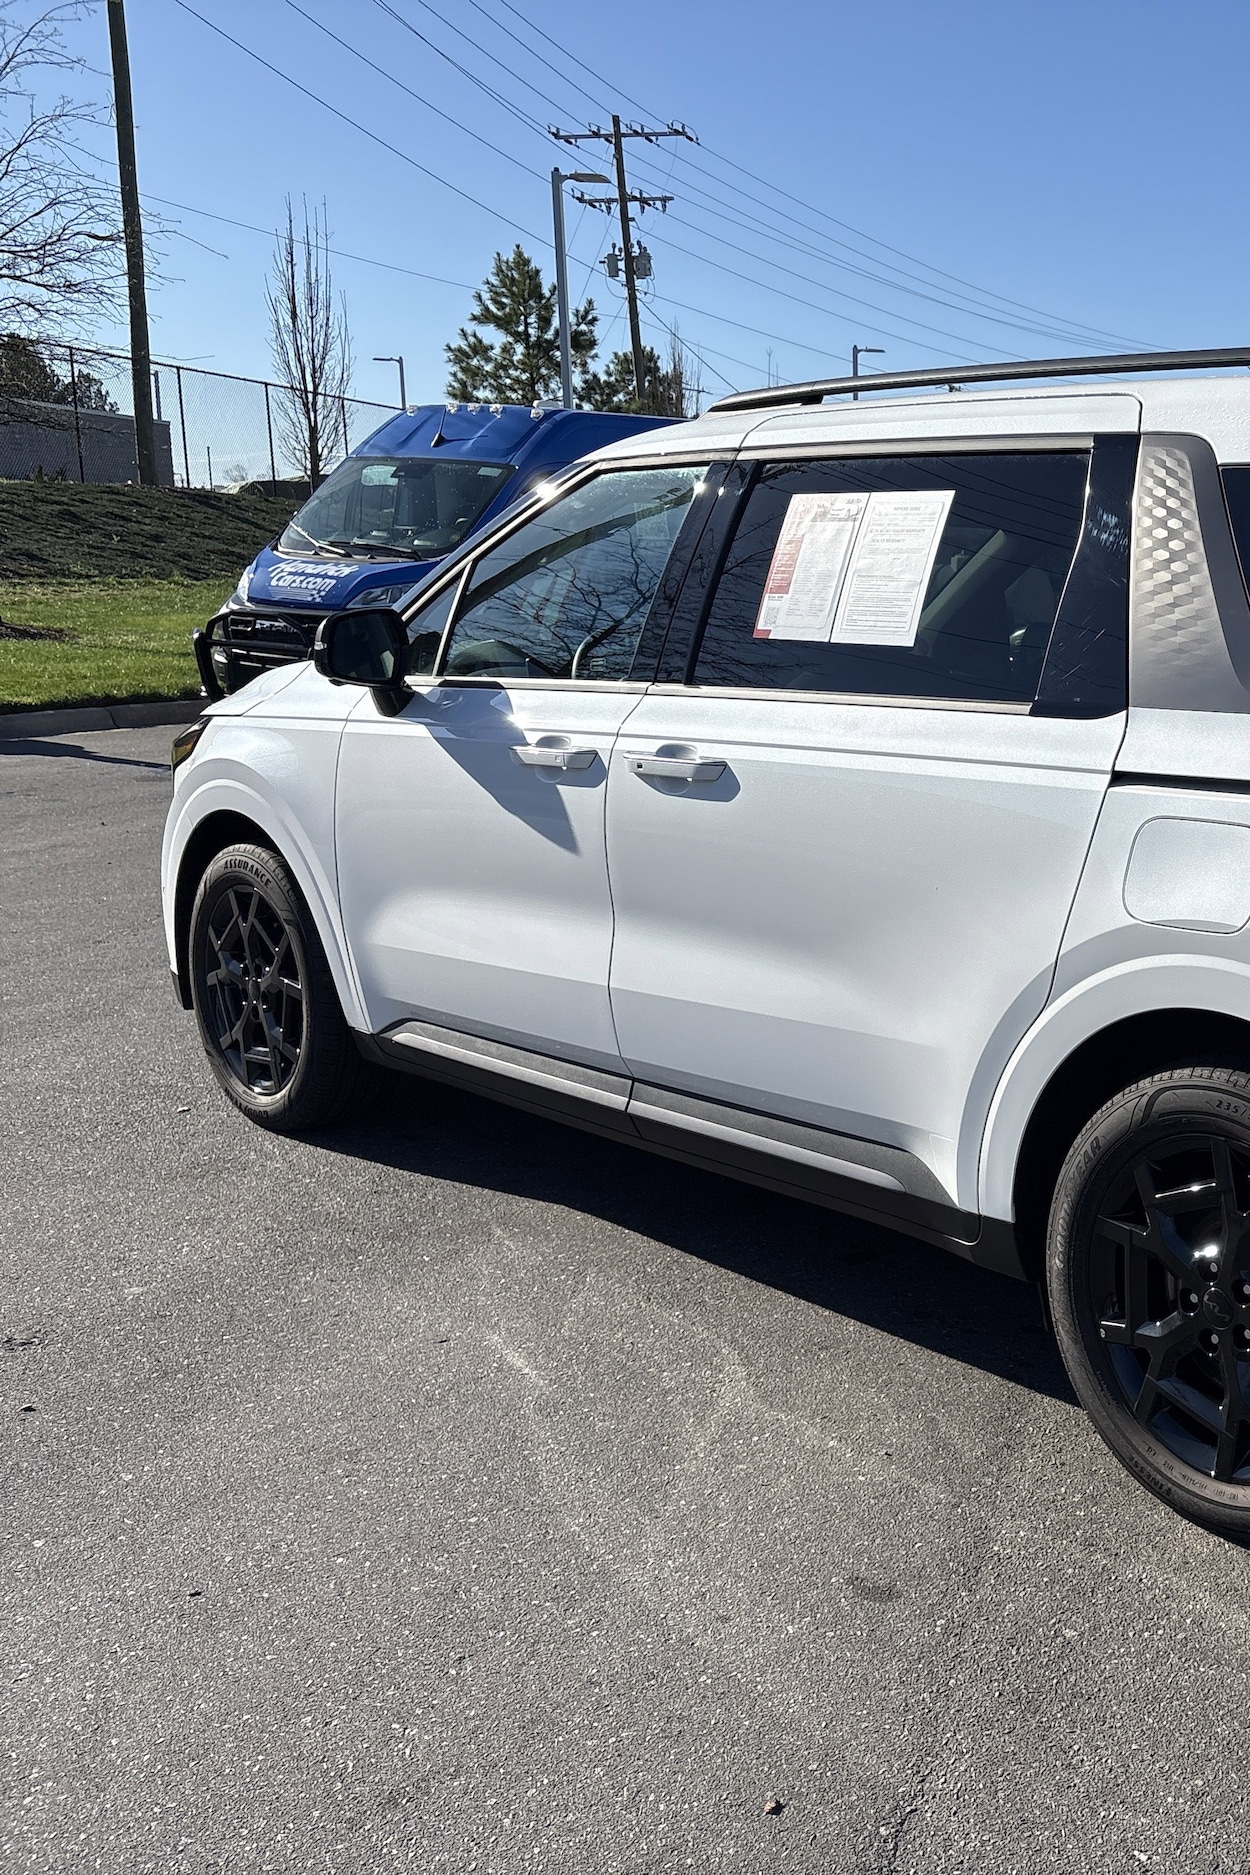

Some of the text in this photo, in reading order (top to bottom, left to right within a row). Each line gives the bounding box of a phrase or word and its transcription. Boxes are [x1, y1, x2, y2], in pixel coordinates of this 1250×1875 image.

[267, 560, 359, 577] Hendrick
[270, 571, 337, 591] Cars.com
[223, 858, 272, 888] ASSURANCE
[1128, 1455, 1173, 1497] FINESSE
